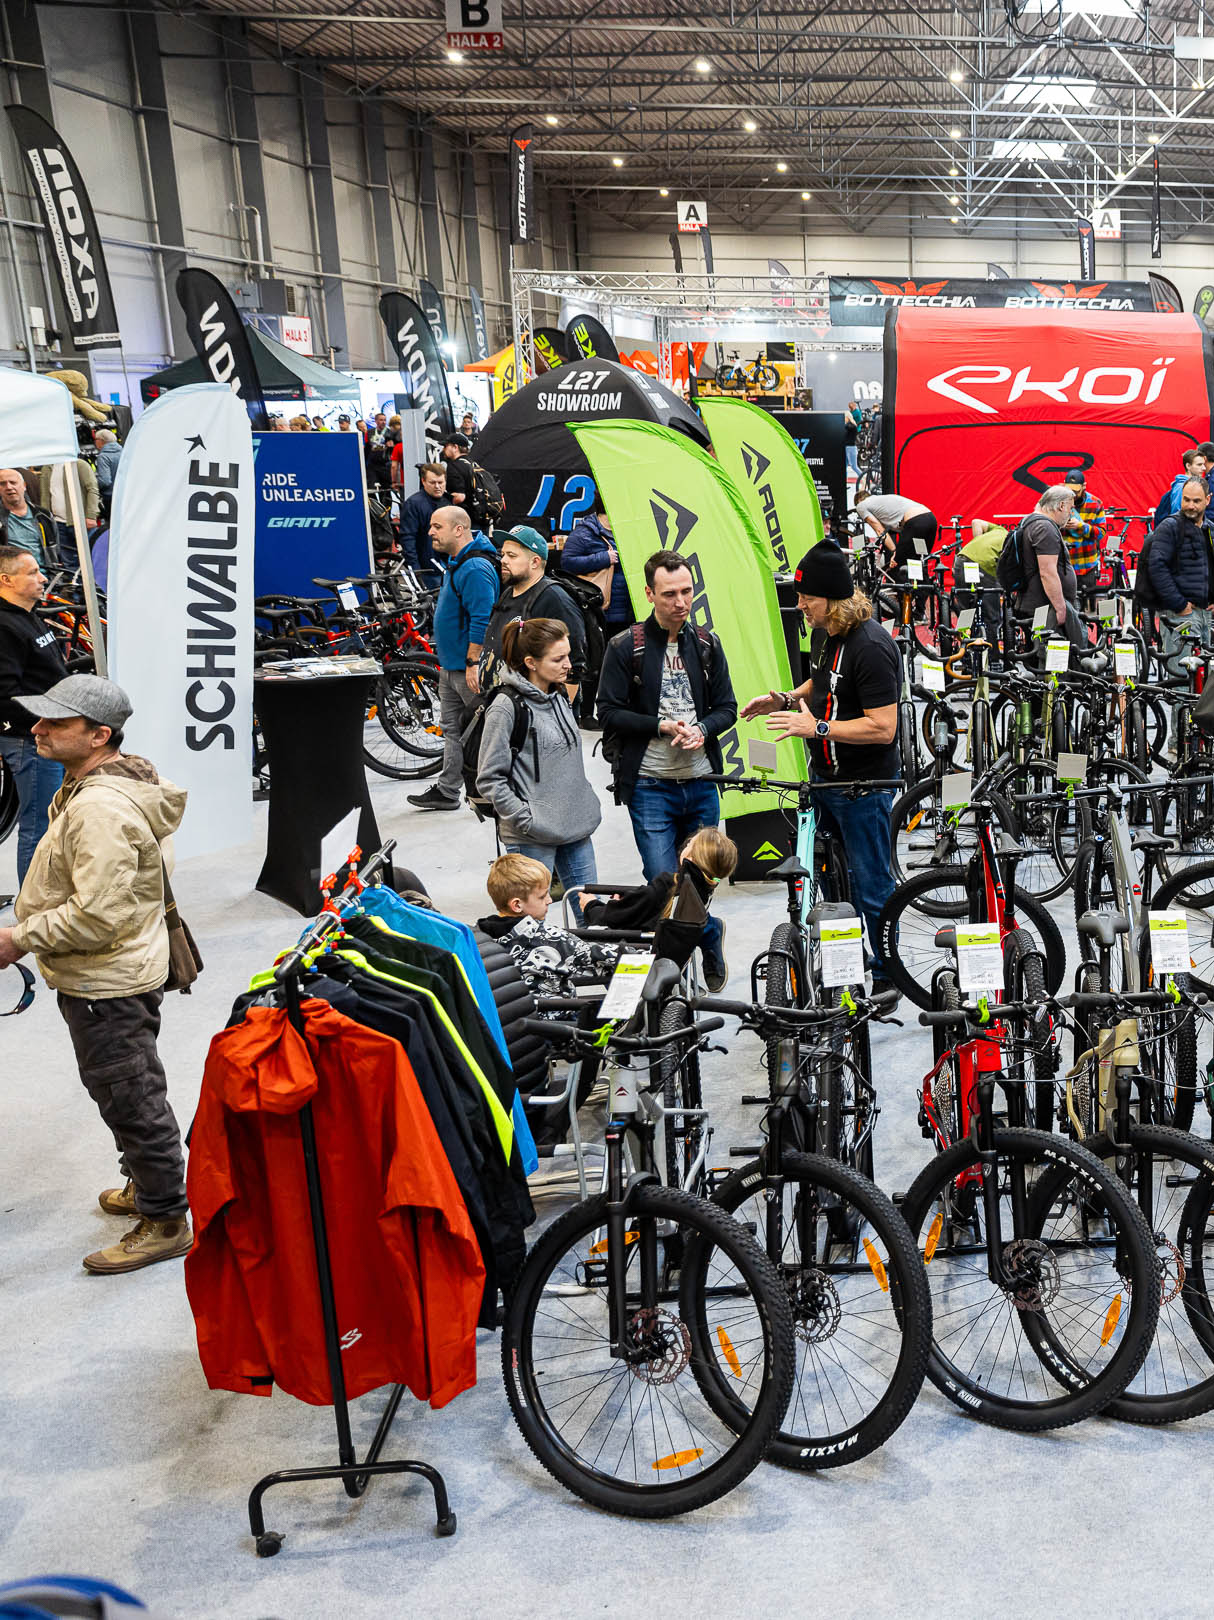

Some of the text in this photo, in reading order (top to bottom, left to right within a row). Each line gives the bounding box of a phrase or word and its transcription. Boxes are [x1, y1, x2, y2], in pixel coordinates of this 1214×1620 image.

[461, 0, 489, 28] B
[450, 33, 501, 48] HALA 2
[518, 153, 528, 239] BOTTECCHIA
[684, 204, 700, 221] A
[1099, 212, 1114, 228] A
[844, 293, 976, 308] BOTTECCHIA
[1005, 296, 1134, 310] BOTTECCHIA
[285, 328, 302, 343] HALA
[558, 371, 610, 390] L27
[537, 391, 622, 412] SHOWROOM
[262, 474, 298, 487] RIDE
[262, 488, 355, 502] UNLEASHED
[267, 517, 337, 528] GIANT
[185, 459, 239, 751] SCHWALBE
[883, 920, 891, 958] MAXXIS
[1044, 1149, 1103, 1190] MAXXIS
[799, 1432, 860, 1457] MAXXIS
